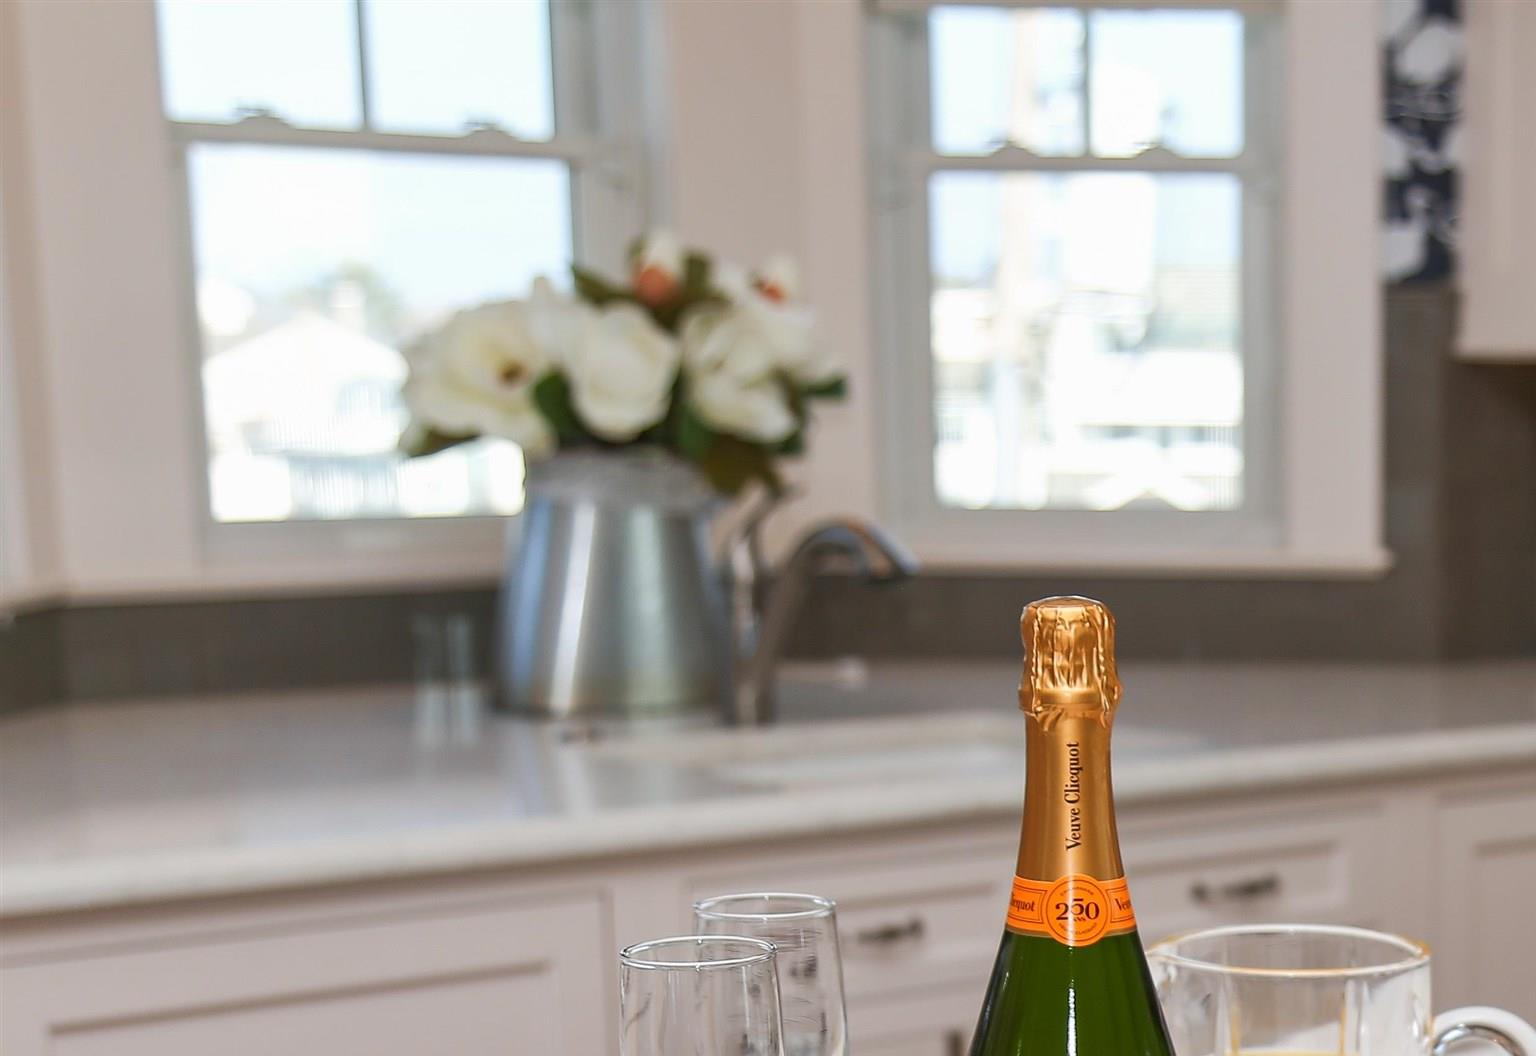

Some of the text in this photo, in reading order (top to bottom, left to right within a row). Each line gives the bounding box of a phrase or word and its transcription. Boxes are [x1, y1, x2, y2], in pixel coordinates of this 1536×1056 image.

[1064, 741, 1083, 851] Veuve Clicquot
[1055, 898, 1100, 921] 250
